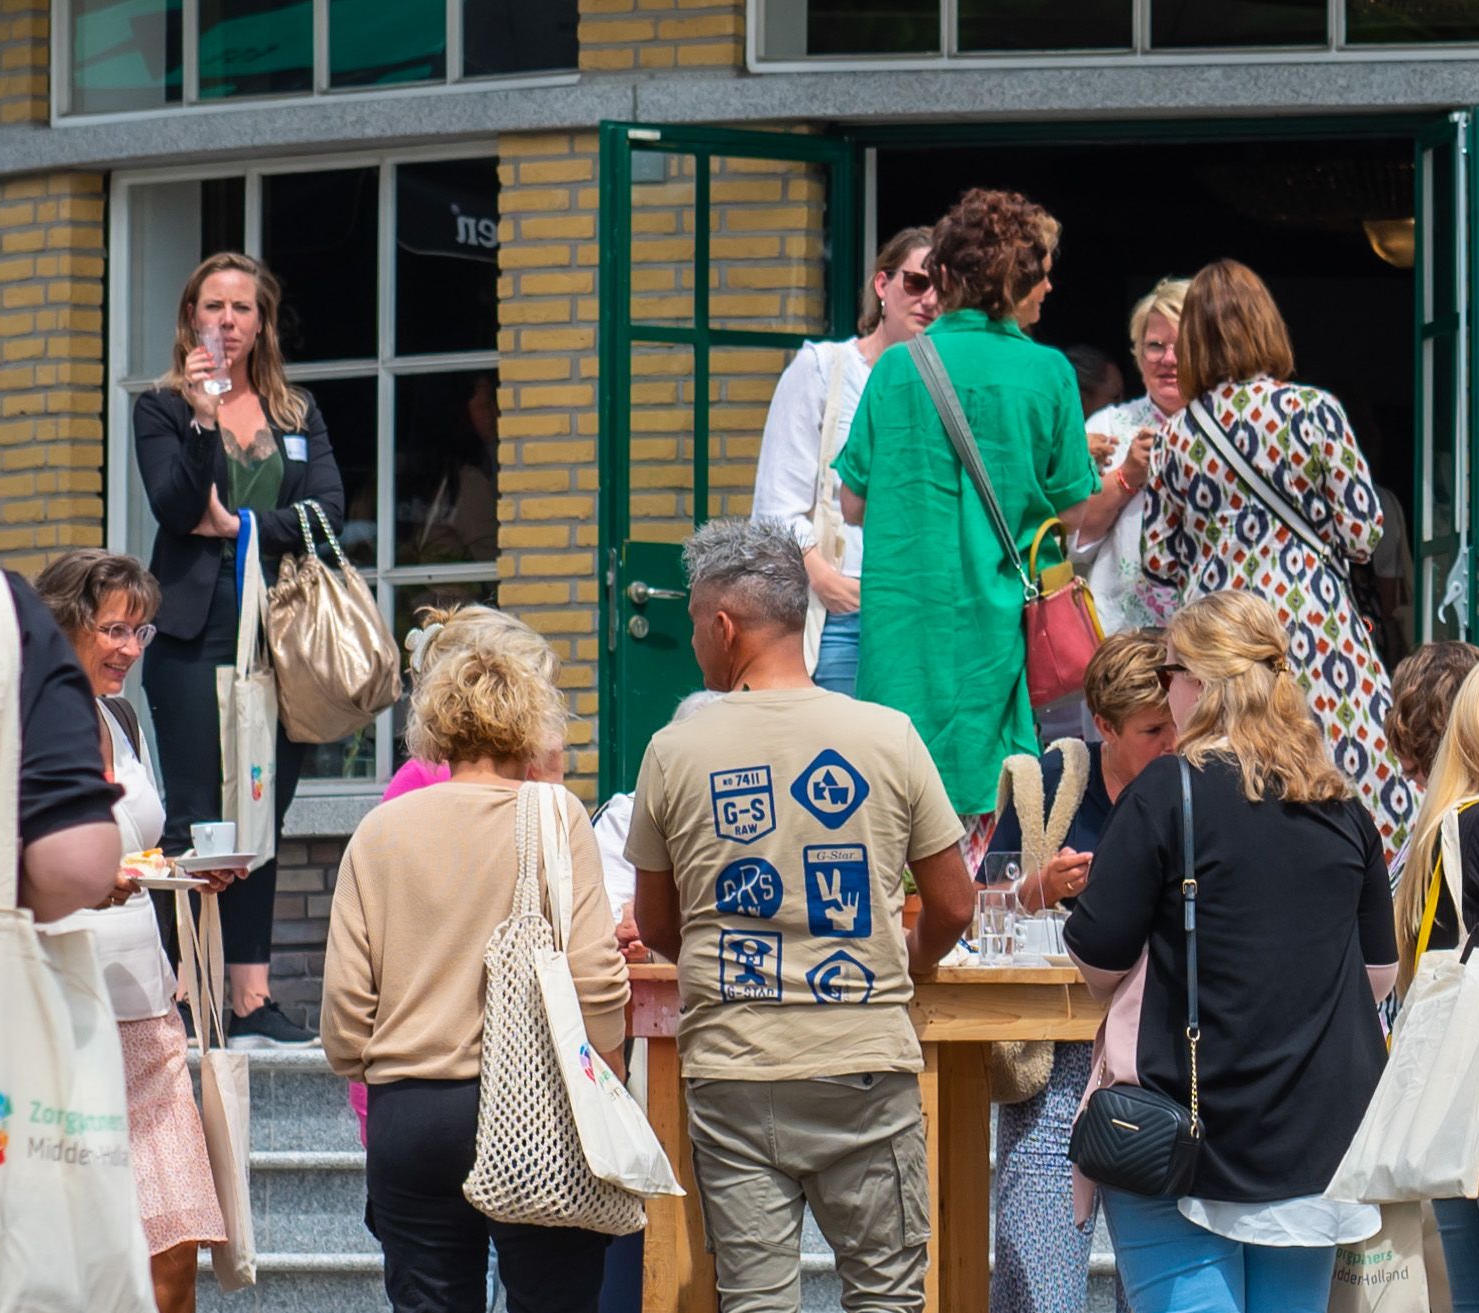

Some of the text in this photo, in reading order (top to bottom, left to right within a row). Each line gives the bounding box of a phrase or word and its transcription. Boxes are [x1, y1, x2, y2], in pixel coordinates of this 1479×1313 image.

[736, 773, 760, 787] 7411
[723, 798, 765, 826] G-S
[735, 823, 758, 836] RAW
[816, 850, 855, 861] G-Star
